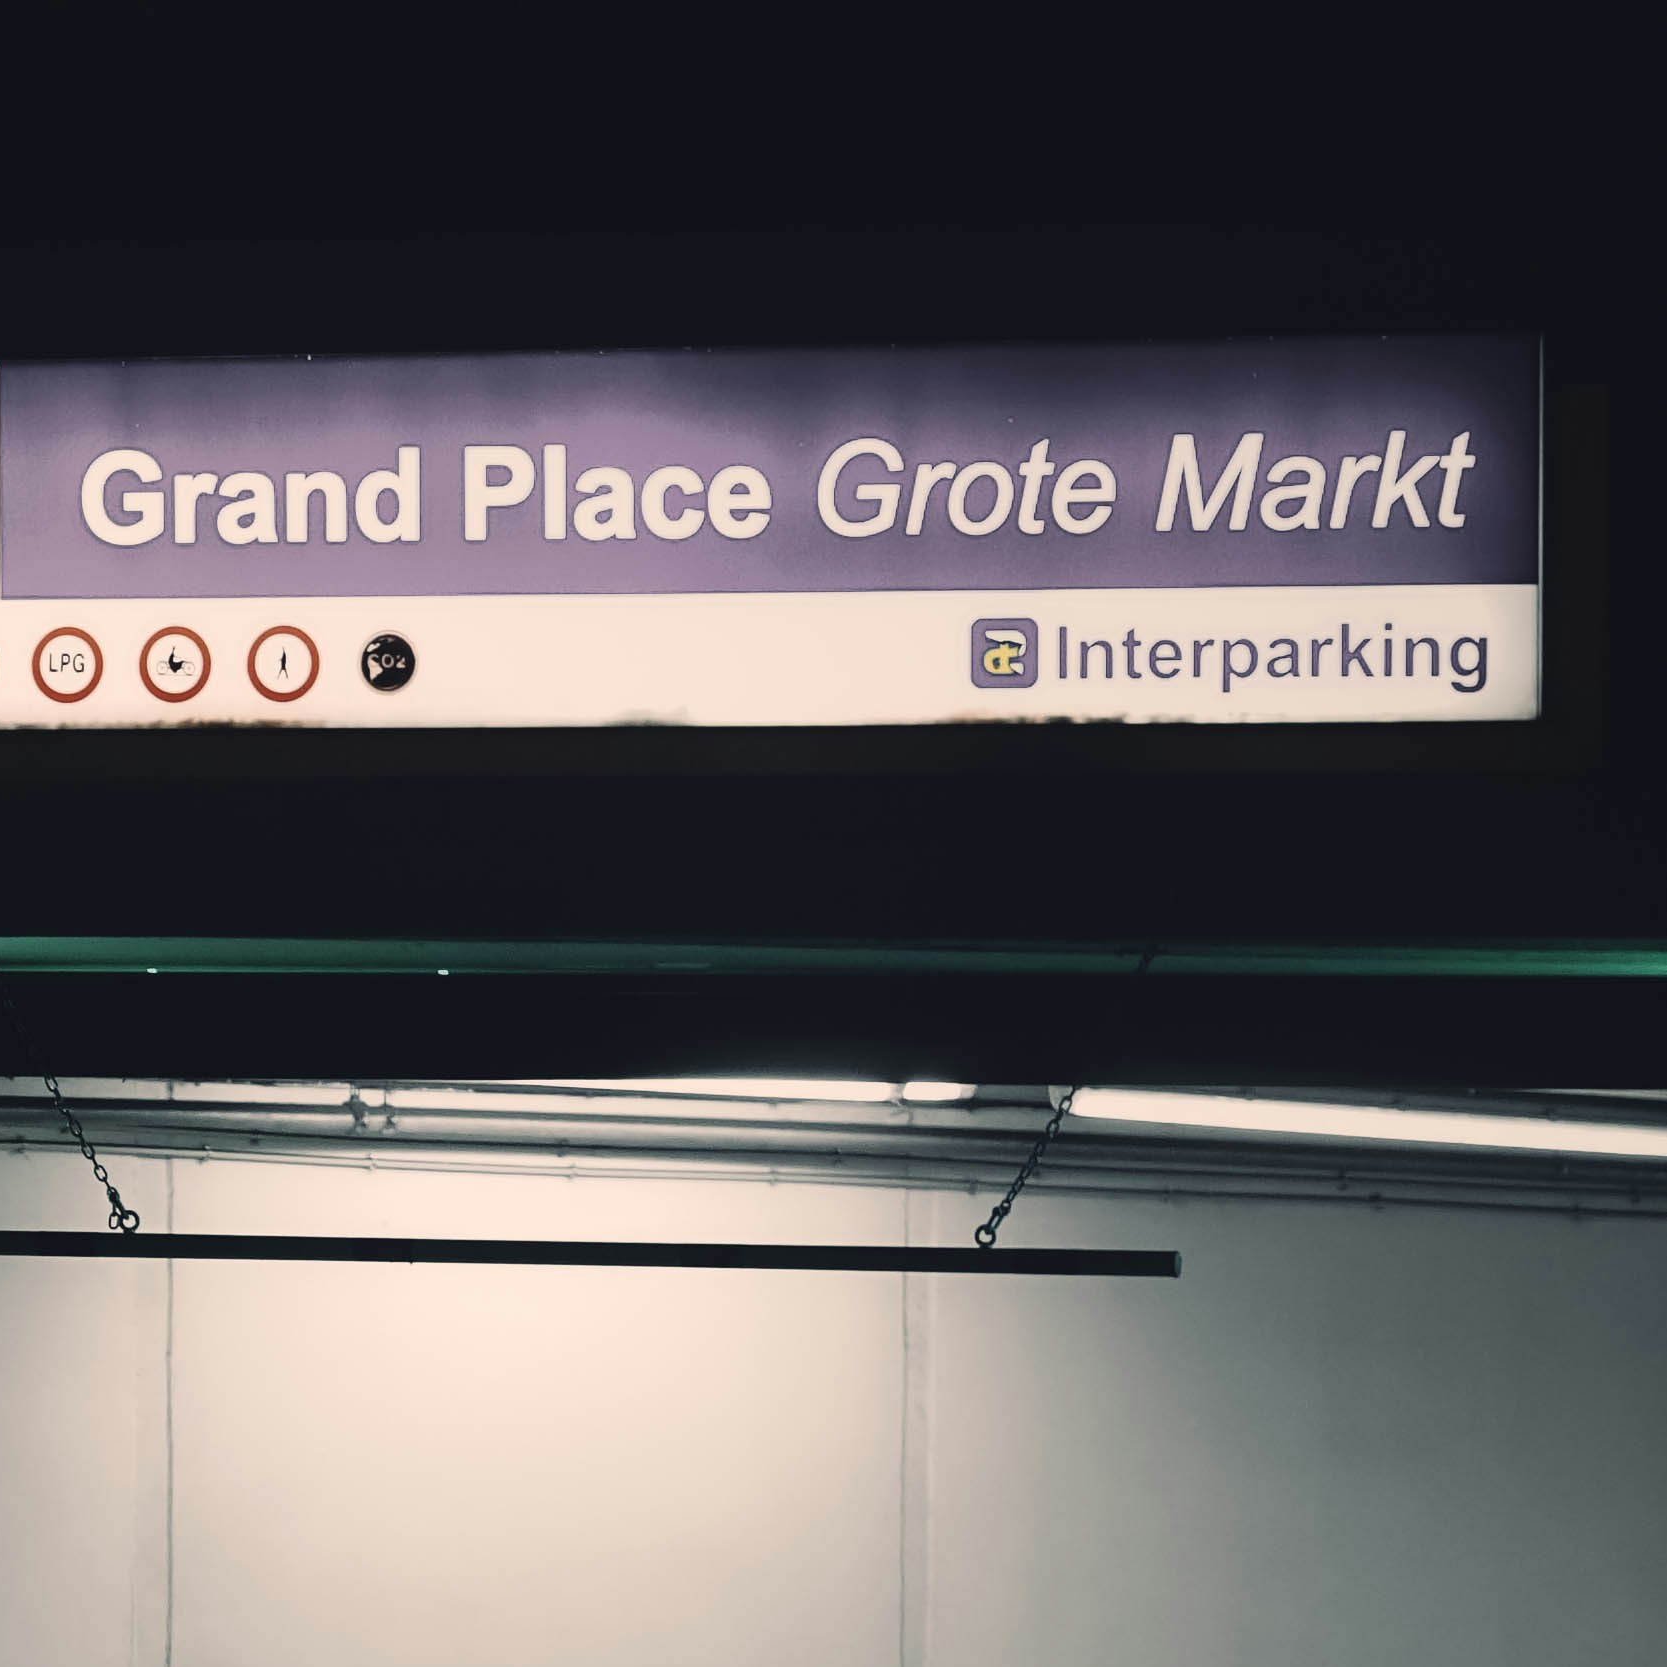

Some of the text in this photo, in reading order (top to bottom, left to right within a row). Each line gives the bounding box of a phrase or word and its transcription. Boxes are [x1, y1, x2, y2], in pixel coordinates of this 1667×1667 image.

[80, 429, 1477, 547] Grand Place Grote Markt
[48, 652, 85, 673] LPG
[1058, 621, 1489, 694] Interparking
